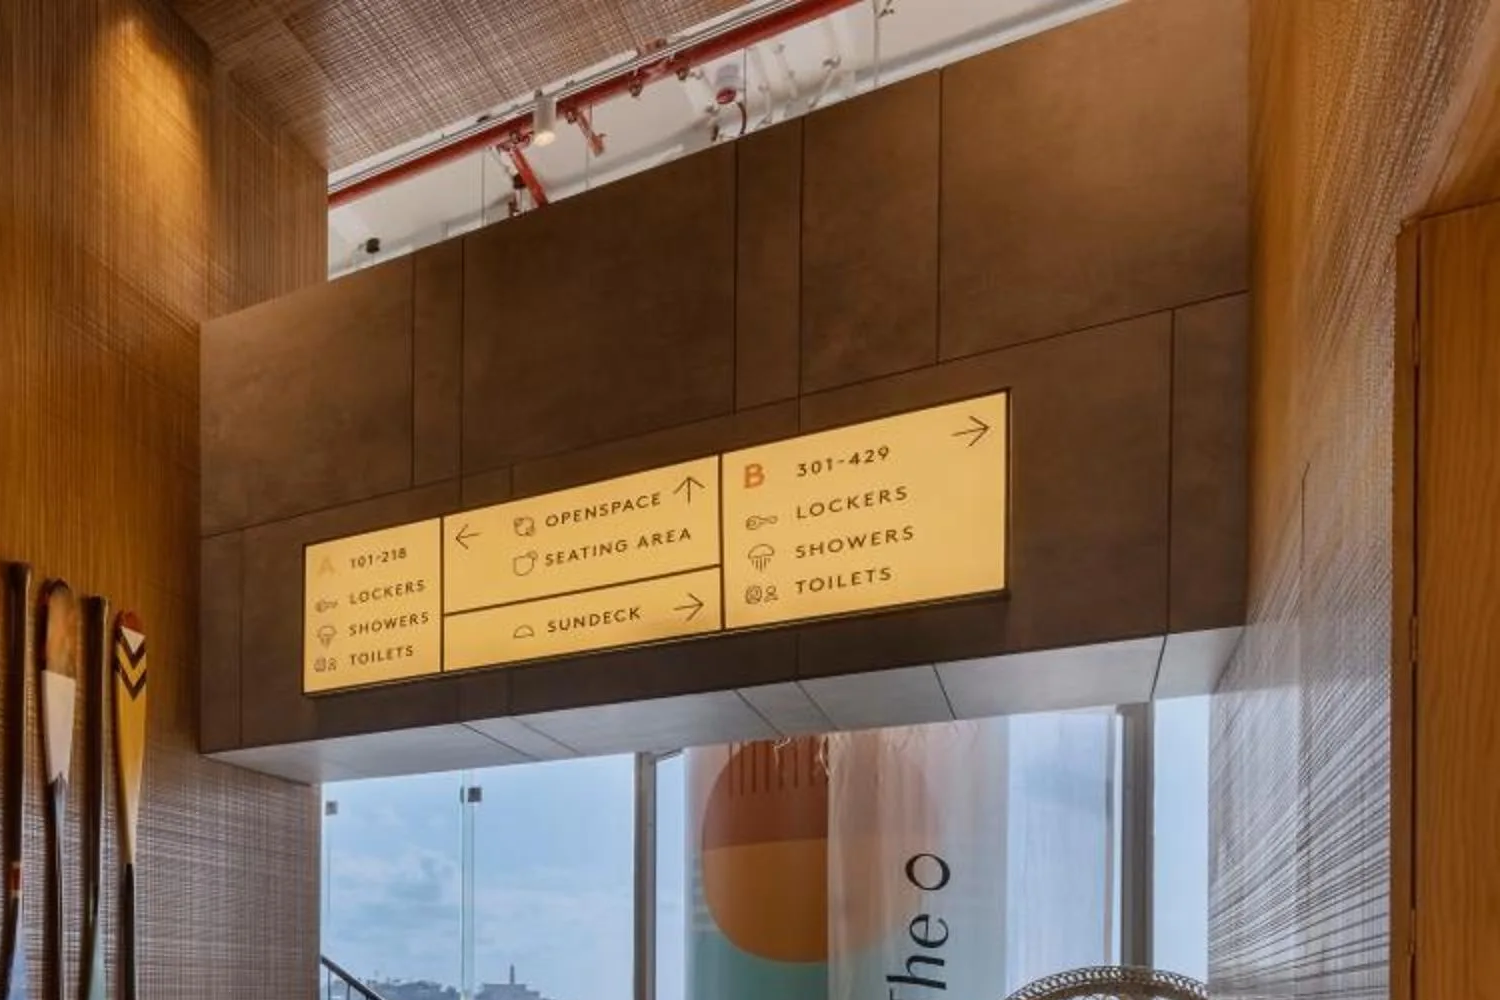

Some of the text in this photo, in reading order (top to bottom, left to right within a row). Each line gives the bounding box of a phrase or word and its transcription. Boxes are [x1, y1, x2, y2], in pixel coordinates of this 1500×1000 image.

[743, 445, 890, 489] B 301-429
[544, 491, 662, 528] OPENSPACE
[796, 485, 908, 520] LOCKERS
[544, 527, 692, 567] SEATING AREA
[795, 525, 914, 559] SHOWERS
[317, 547, 407, 577] A 101-218
[348, 579, 426, 605] LOCKERS
[795, 566, 892, 595] TOILETS
[348, 612, 430, 637] SHOWERS
[547, 606, 641, 633] SUNDECK
[349, 645, 414, 666] TOILETS
